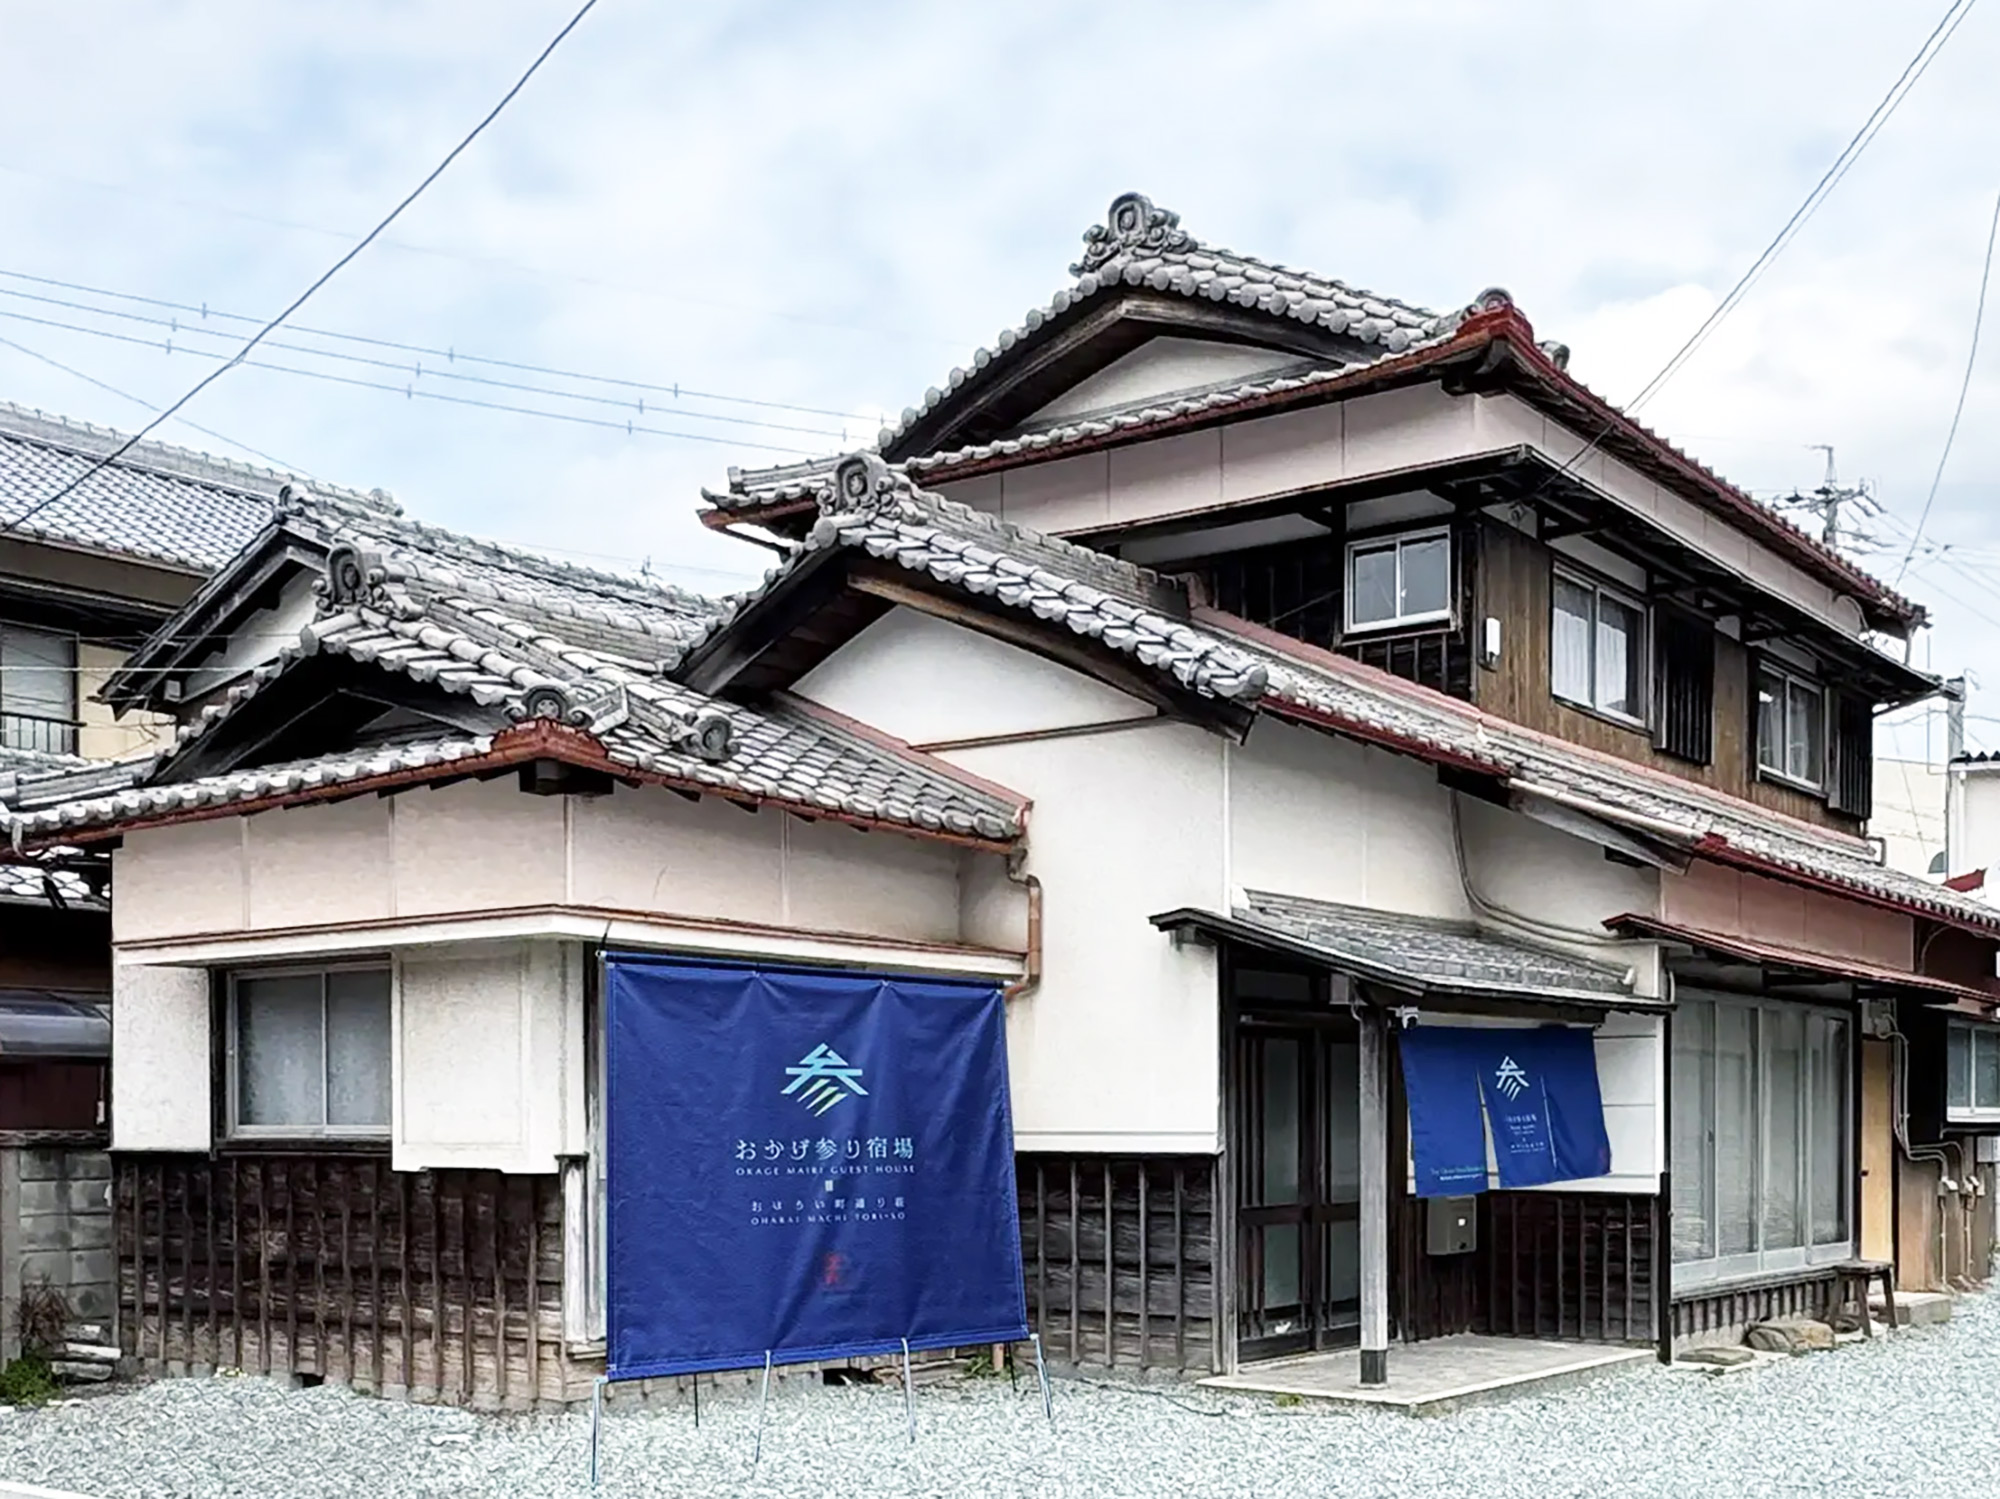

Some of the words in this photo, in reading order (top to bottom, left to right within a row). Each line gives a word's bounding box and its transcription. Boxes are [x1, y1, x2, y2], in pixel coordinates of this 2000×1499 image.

[735, 1136, 914, 1161] おかげ参り宿場
[735, 1167, 780, 1176] OKAGE
[786, 1166, 824, 1176] MAIRI
[830, 1165, 869, 1175] GUEST
[875, 1164, 916, 1174] HOUSE
